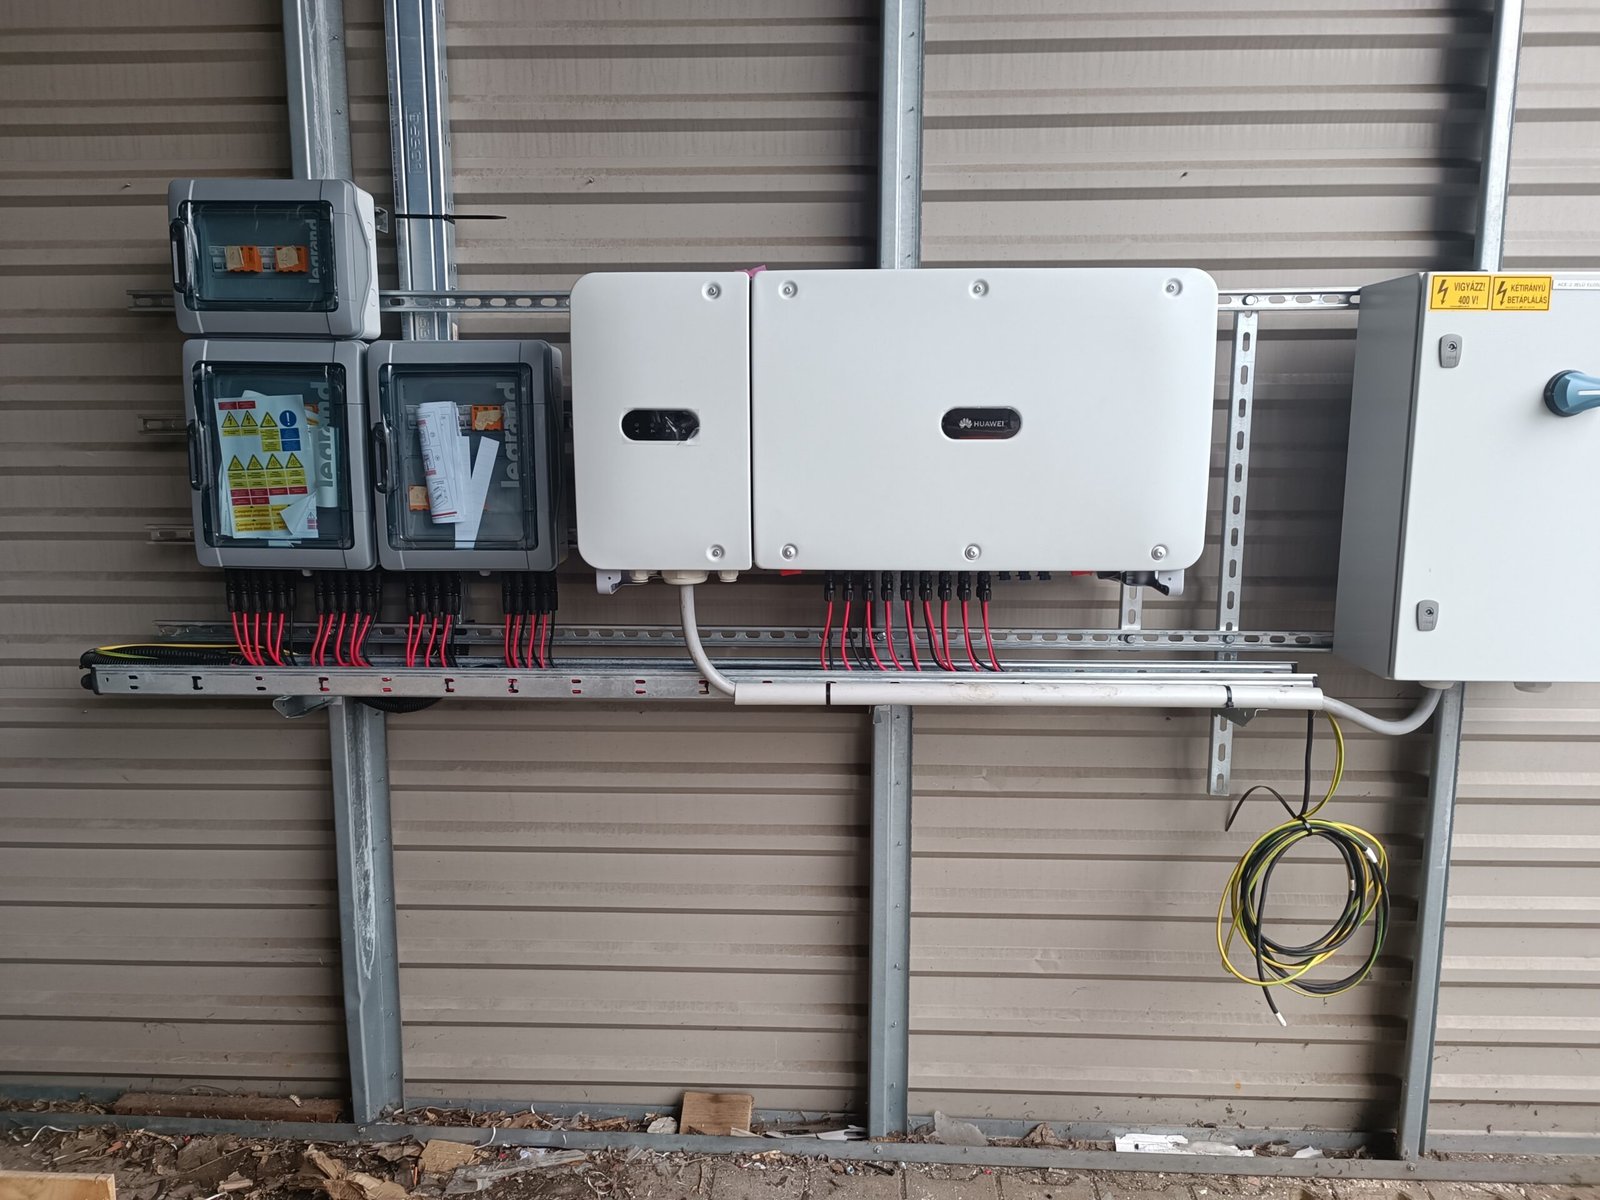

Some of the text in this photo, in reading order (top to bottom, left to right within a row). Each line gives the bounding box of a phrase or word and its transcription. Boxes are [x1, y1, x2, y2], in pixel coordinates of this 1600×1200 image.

[305, 219, 320, 284] legrand
[1454, 281, 1485, 292] VIGYÁZZ!
[1510, 283, 1546, 292] KÉTIRÁNYÚ
[1458, 295, 1478, 304] 400 V!
[1507, 295, 1547, 304] BETÁPLÁLÁS
[496, 382, 520, 488] legrand
